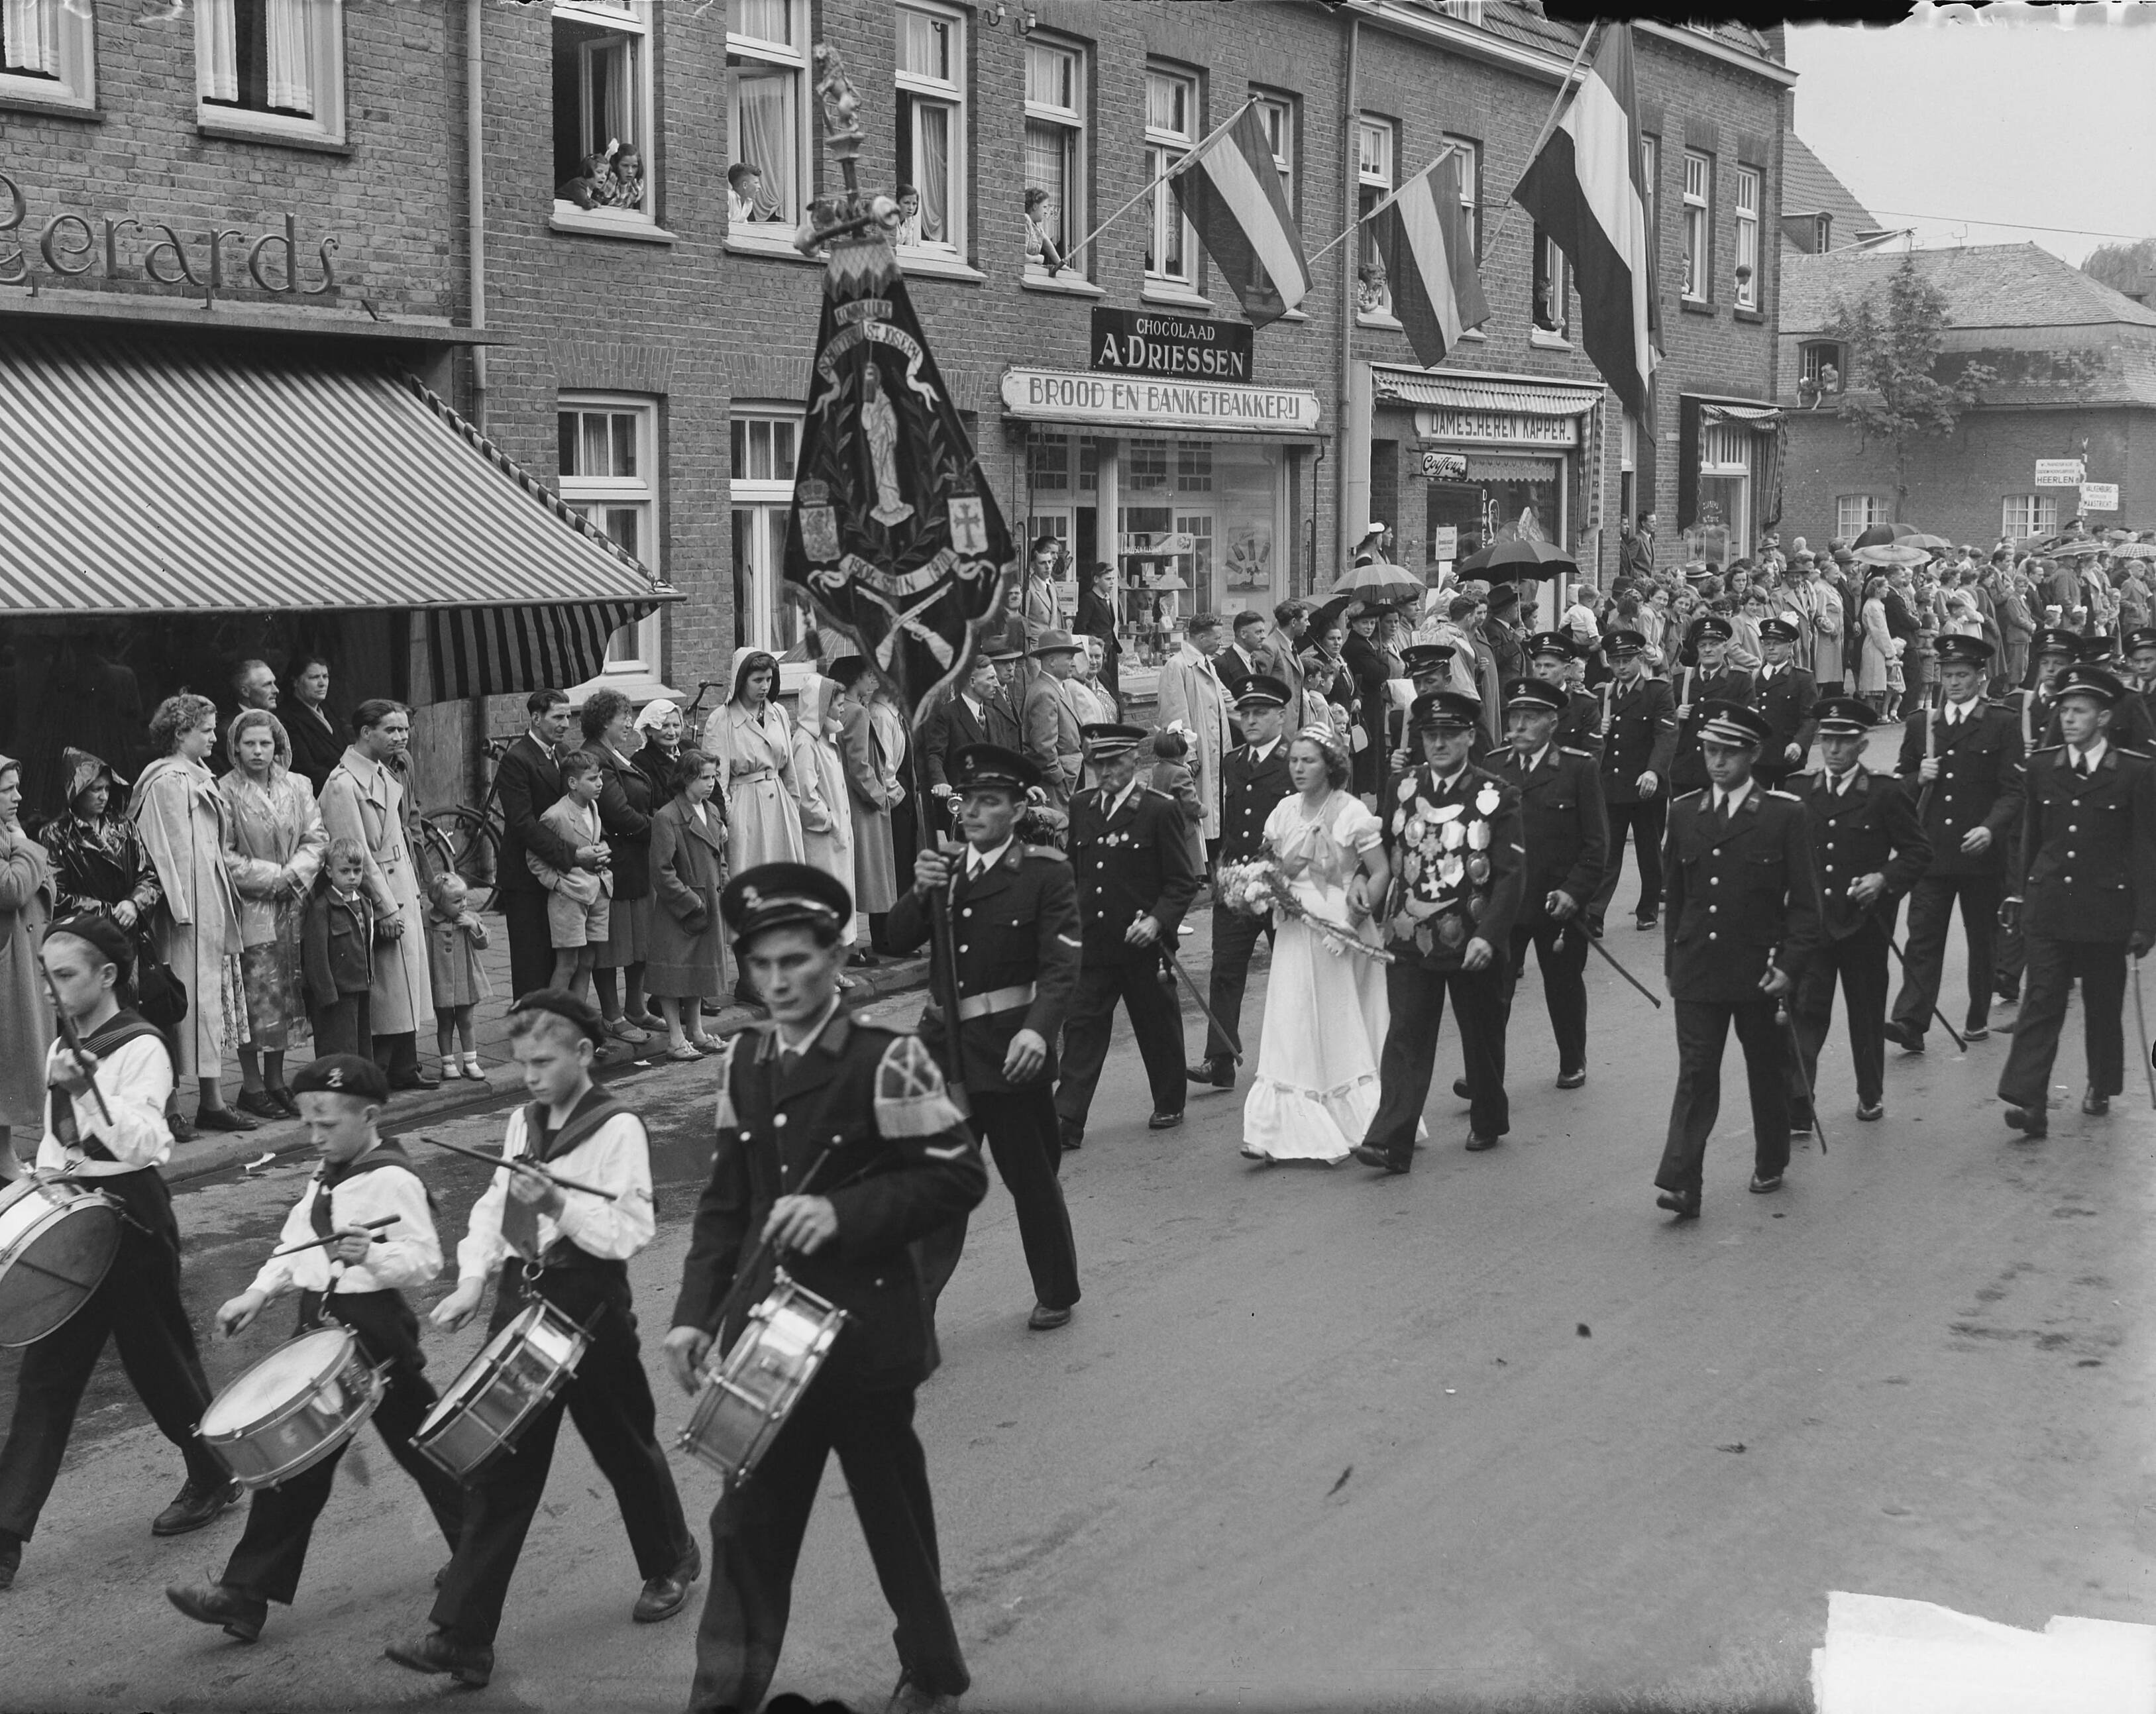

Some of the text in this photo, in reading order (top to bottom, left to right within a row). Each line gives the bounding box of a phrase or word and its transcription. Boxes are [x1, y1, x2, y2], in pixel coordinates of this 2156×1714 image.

[1136, 318, 1216, 341] CHOCOLAAD
[1029, 377, 1301, 421] BROOD EN BANKETBAKKERIJ
